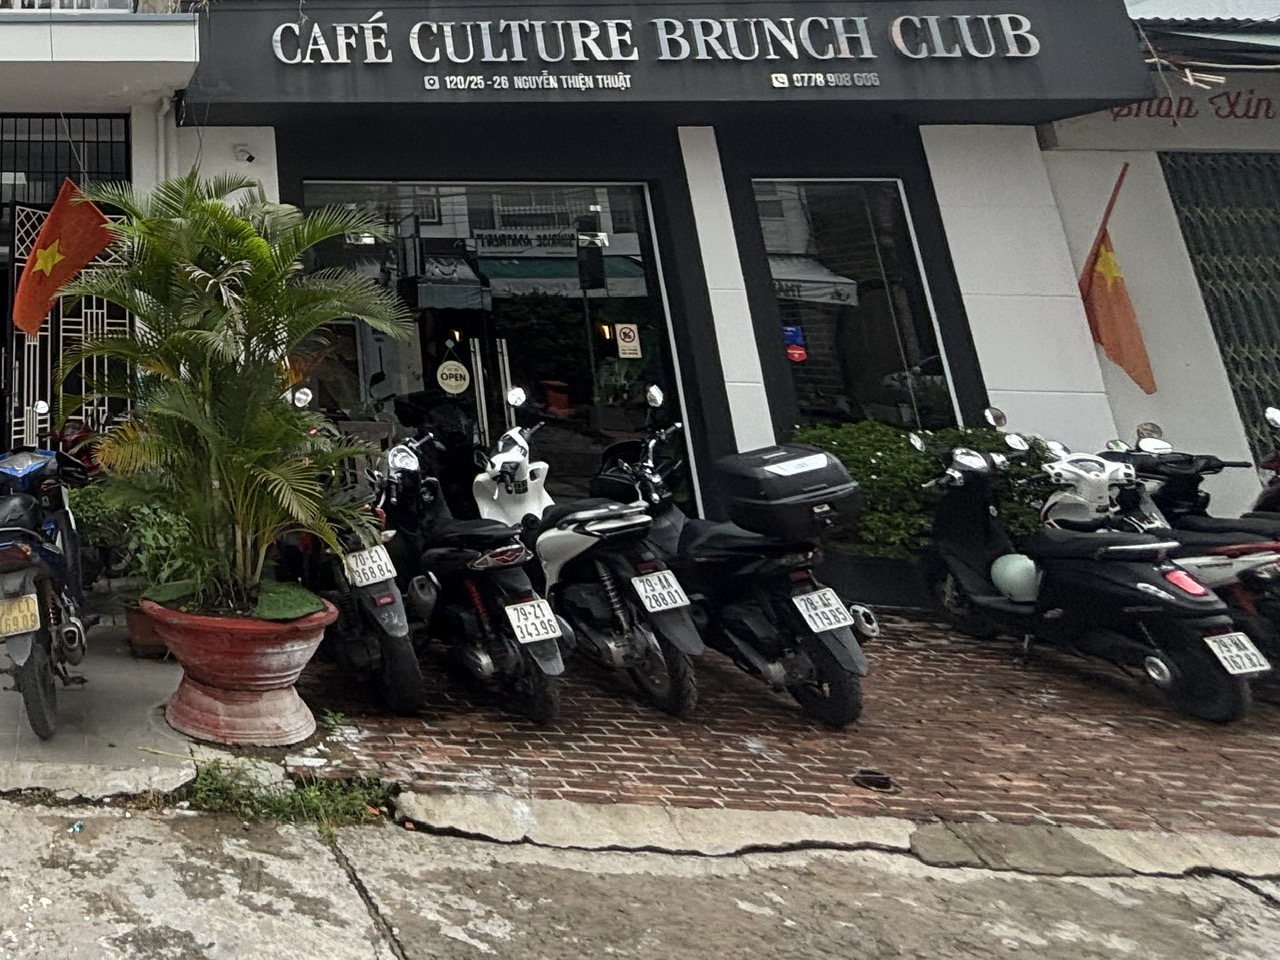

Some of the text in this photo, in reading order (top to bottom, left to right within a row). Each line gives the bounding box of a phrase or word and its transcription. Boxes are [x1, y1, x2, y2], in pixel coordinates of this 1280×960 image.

[272, 11, 1041, 64] CAFÉ CULTURE BRUNCH CLUB
[513, 70, 559, 90] NGUYỄN
[560, 73, 595, 91] THIỆN
[596, 72, 632, 91] THUẬT
[792, 72, 880, 87] 0778 908 606
[440, 372, 467, 382] OPEN
[644, 589, 685, 609] 288.01
[808, 607, 848, 629] 119.85
[516, 618, 557, 640] 343.96
